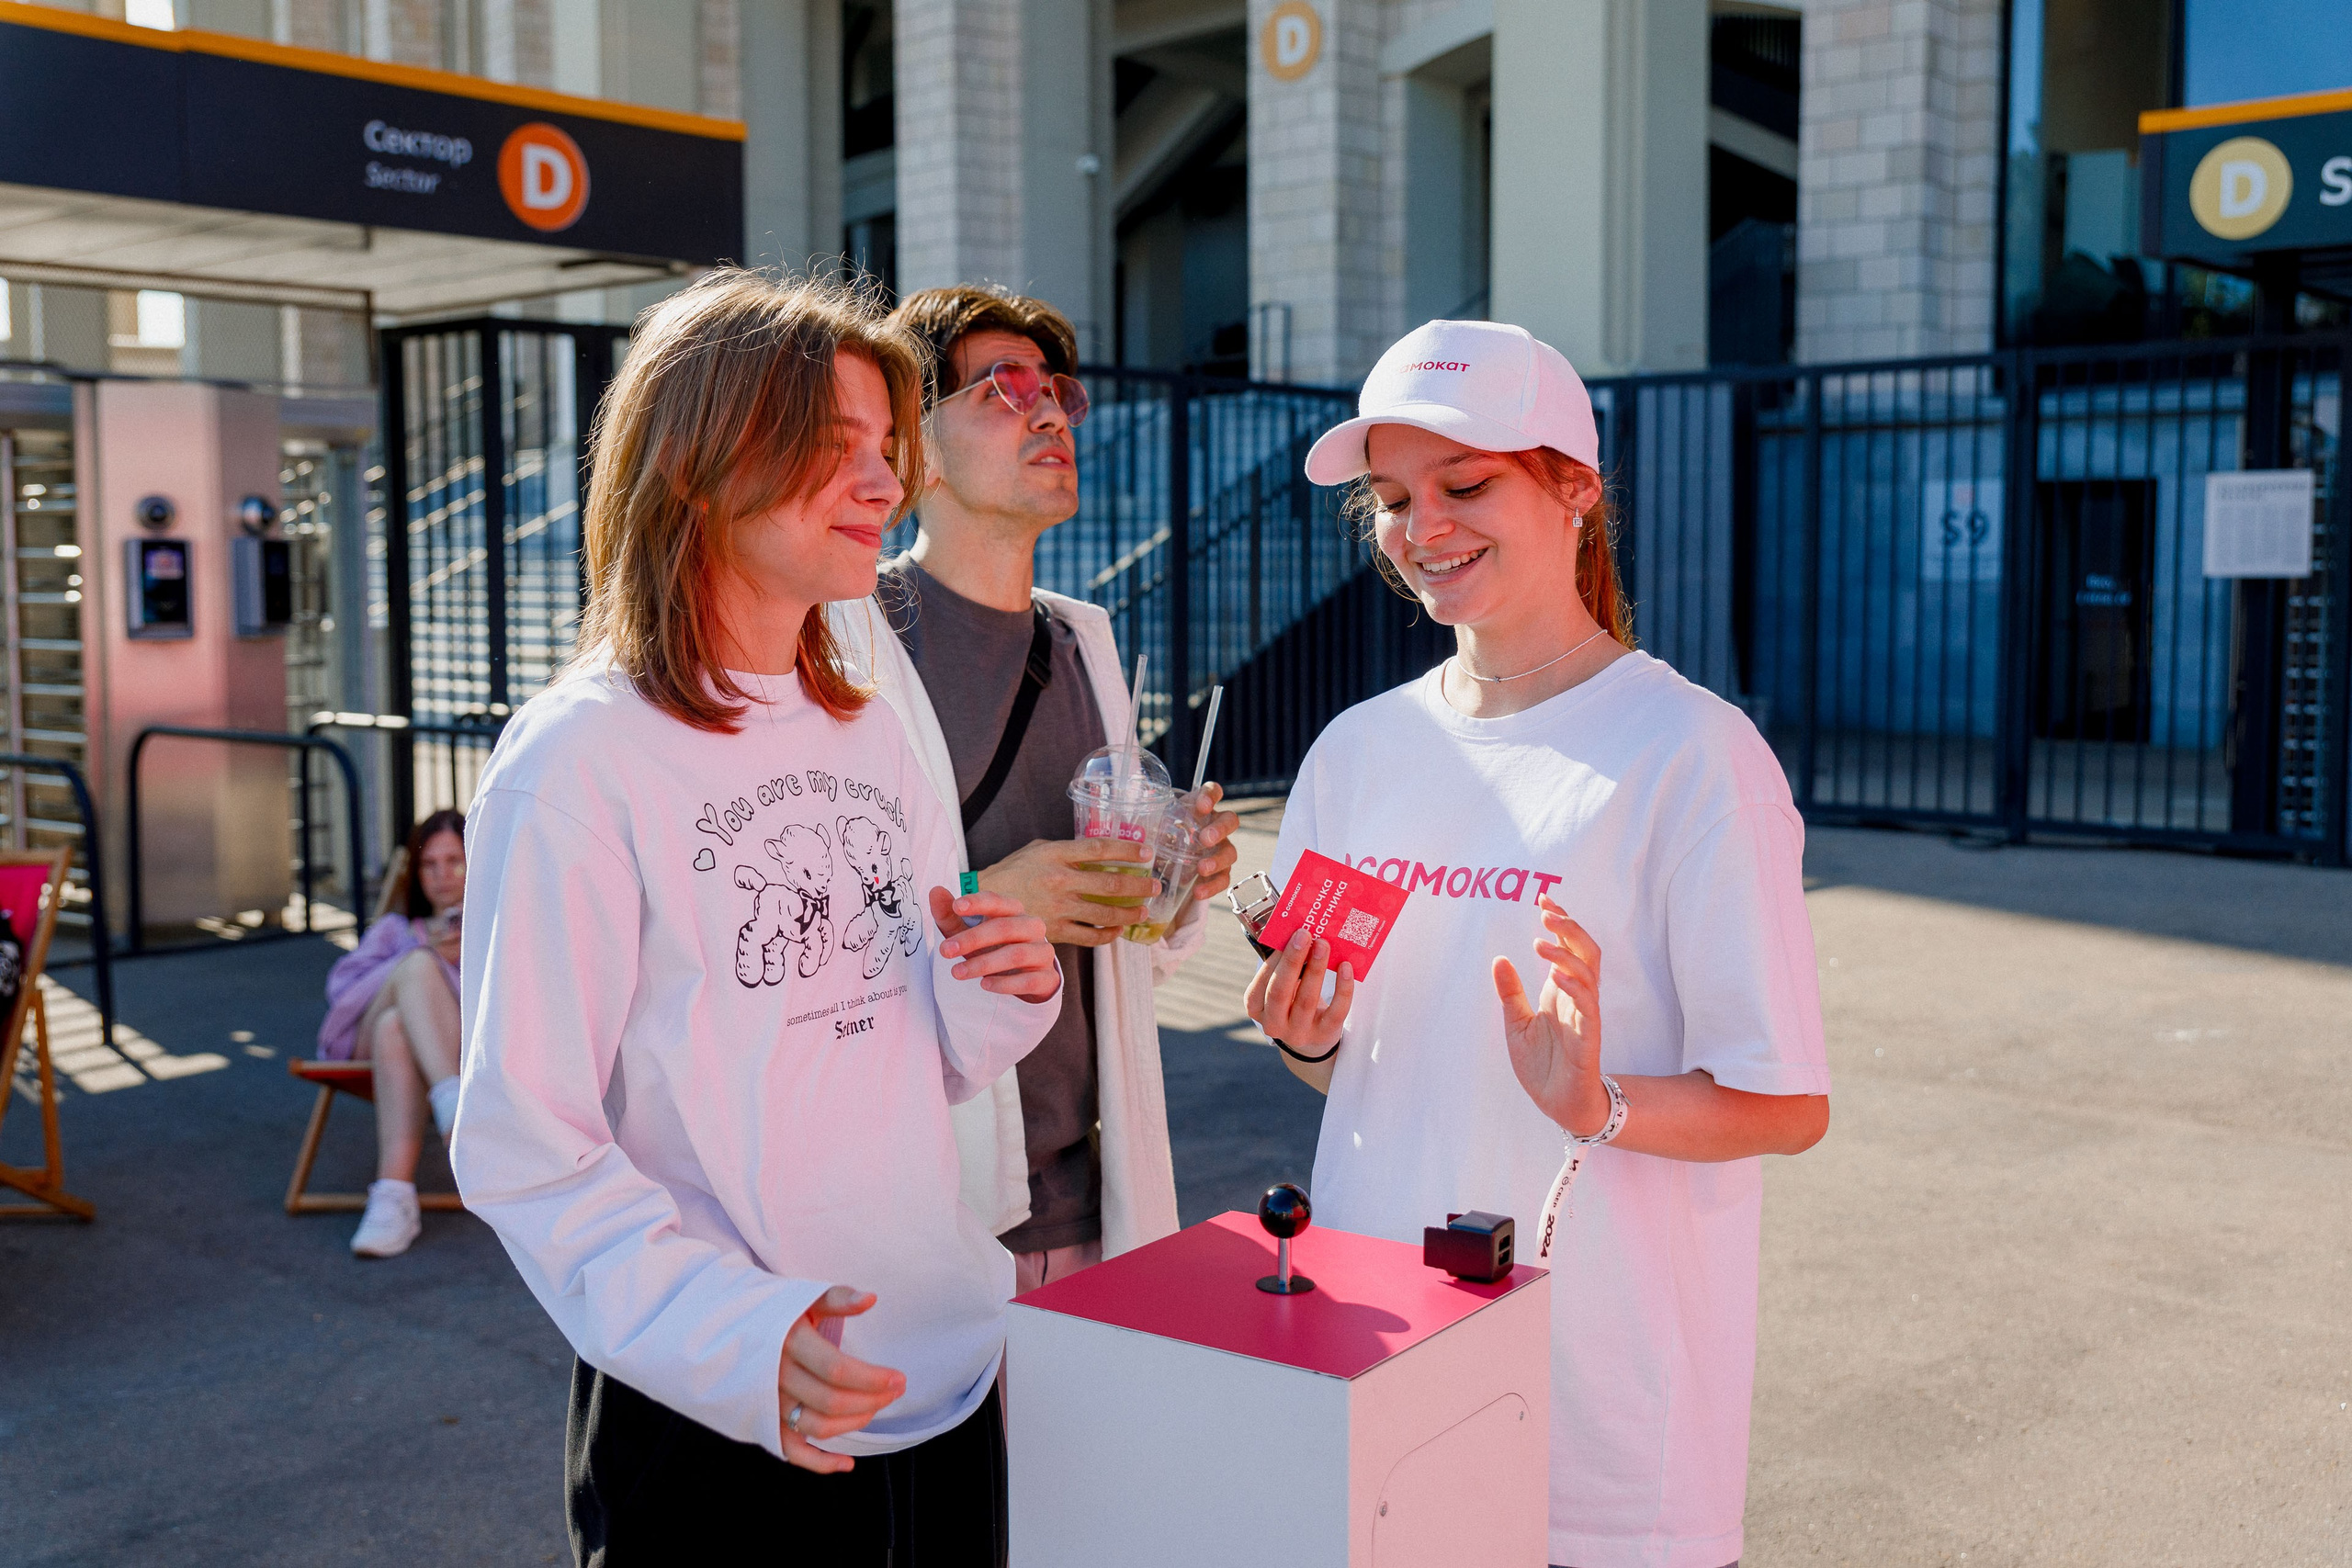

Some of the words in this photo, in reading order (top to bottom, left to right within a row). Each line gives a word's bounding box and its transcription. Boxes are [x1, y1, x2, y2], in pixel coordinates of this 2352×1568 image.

[1276, 14, 1311, 67] D
[363, 119, 473, 168] Сектор
[365, 160, 441, 195] Sector
[521, 142, 573, 210] D
[2220, 159, 2267, 220] D
[695, 796, 754, 846] You
[756, 773, 803, 807] are
[806, 770, 838, 802] my
[844, 778, 907, 833] crush
[1285, 882, 1303, 911] самокат
[1301, 878, 1334, 932] арточка
[1310, 880, 1349, 946] частника
[786, 1007, 830, 1027] sometimes
[830, 1002, 839, 1014] all
[841, 1000, 846, 1011] I
[847, 995, 866, 1010] think
[867, 988, 894, 1003] about
[893, 987, 899, 997] is
[898, 984, 908, 997] you
[1540, 1213, 1555, 1258] 2024
